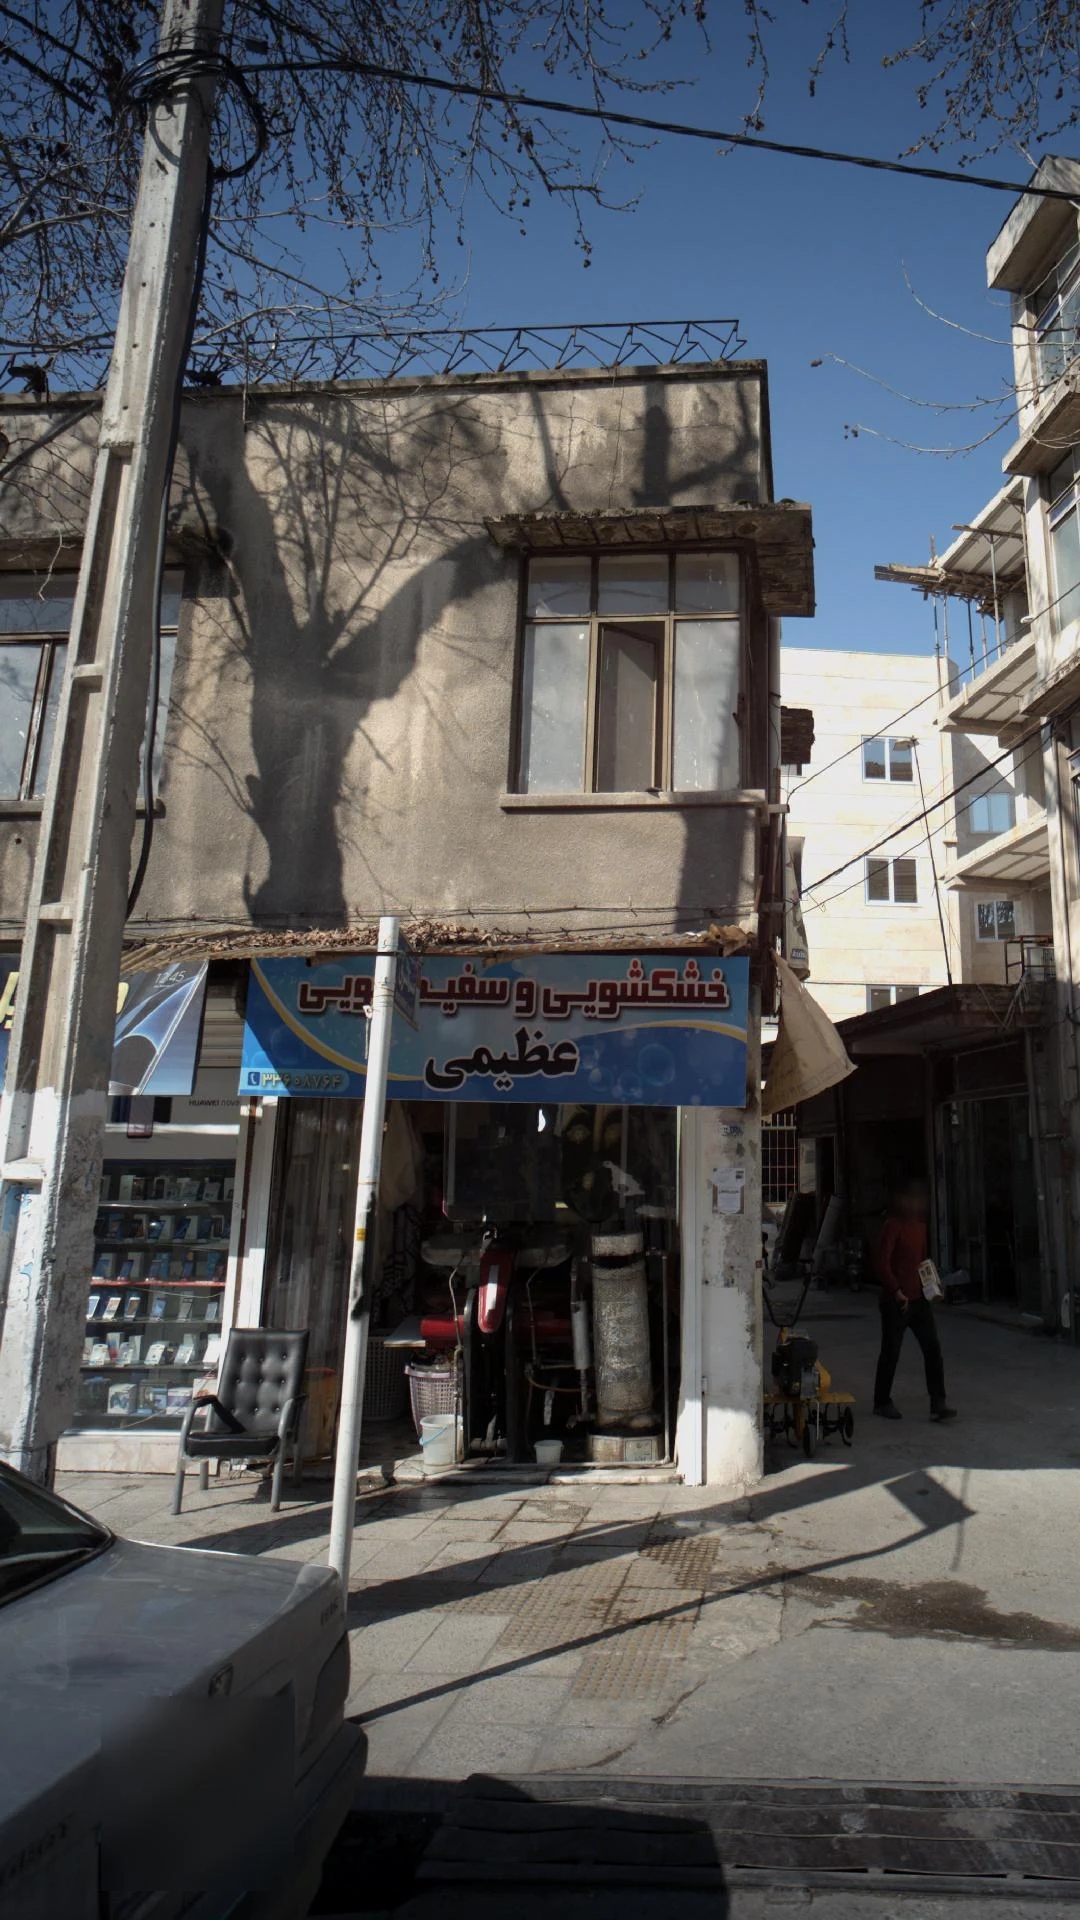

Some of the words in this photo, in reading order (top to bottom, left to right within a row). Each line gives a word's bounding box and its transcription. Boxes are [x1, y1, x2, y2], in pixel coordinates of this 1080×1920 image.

[514, 979, 535, 1015] و
[543, 958, 728, 1015] خشکشویی
[425, 1026, 578, 1090] عظیمی
